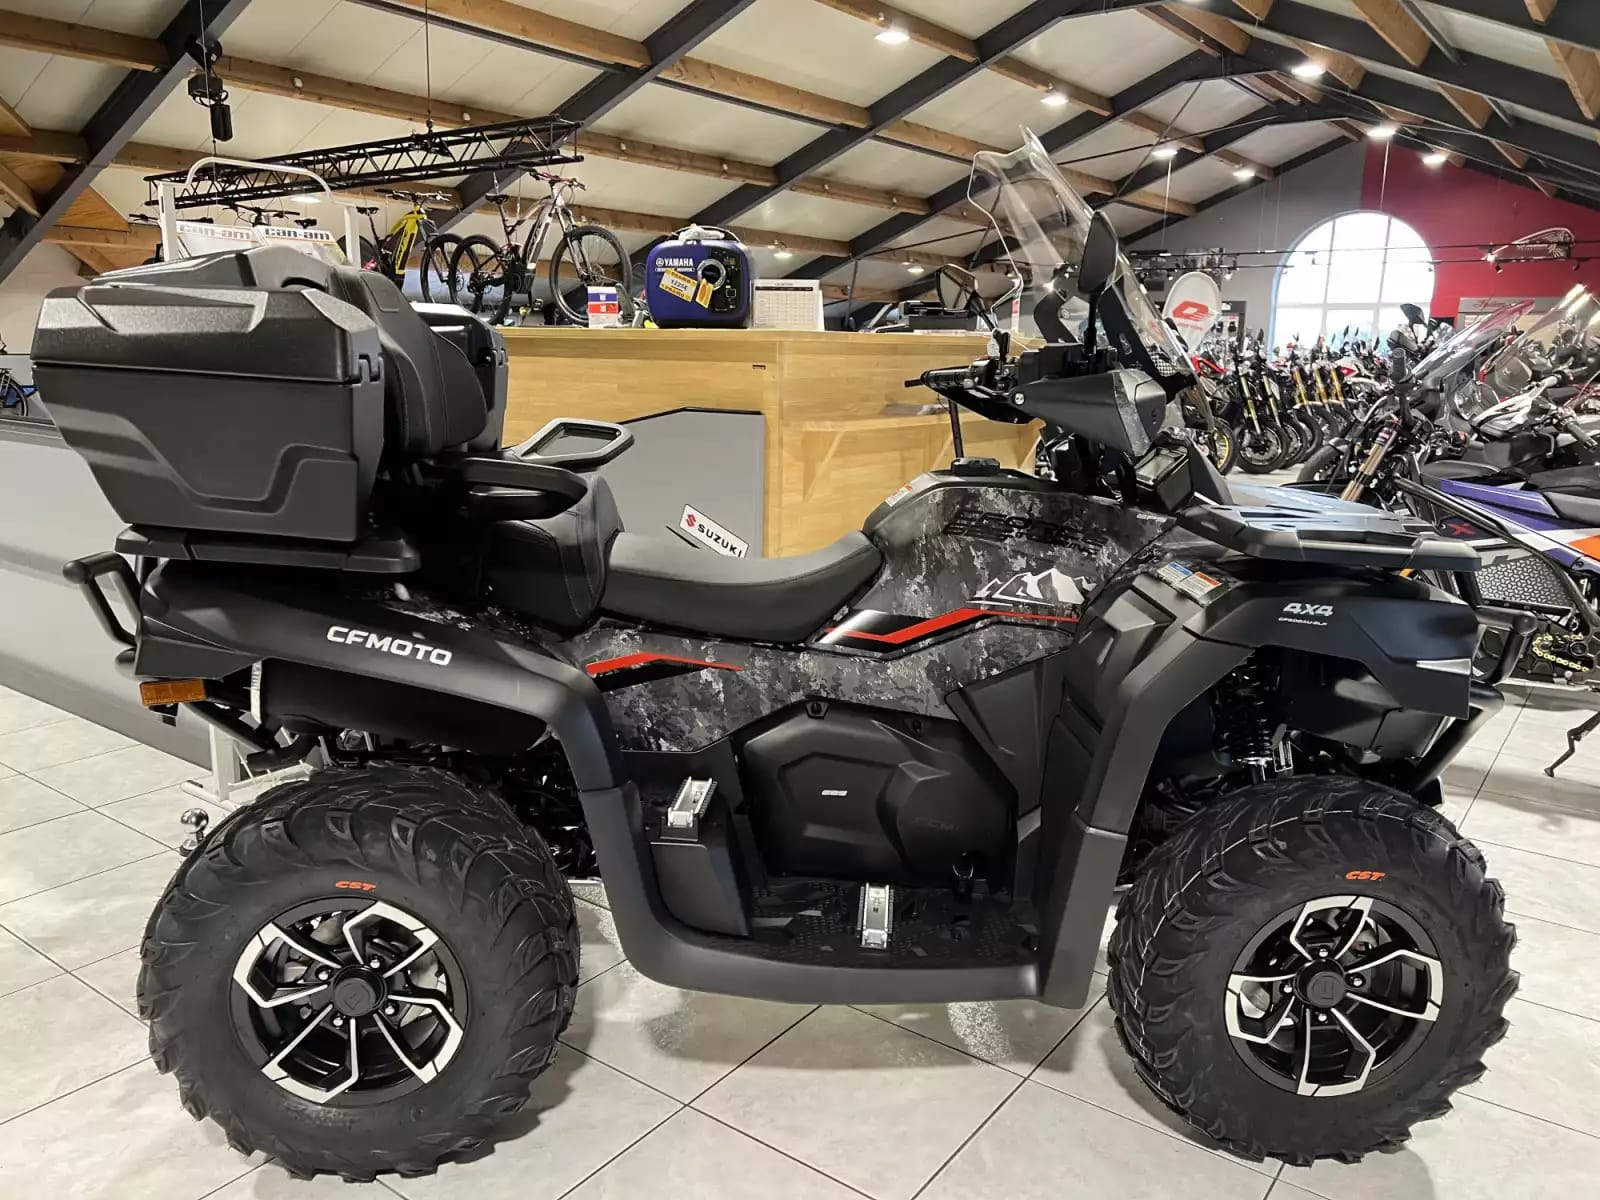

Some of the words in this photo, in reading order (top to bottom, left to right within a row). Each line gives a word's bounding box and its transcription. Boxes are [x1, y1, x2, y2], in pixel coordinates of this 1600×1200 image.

[264, 227, 331, 241] can-am
[664, 257, 693, 266] YAMAHA
[697, 523, 742, 558] SUZUKI
[326, 625, 453, 666] CFMOTO
[1345, 870, 1385, 881] CST
[335, 880, 377, 891] CST
